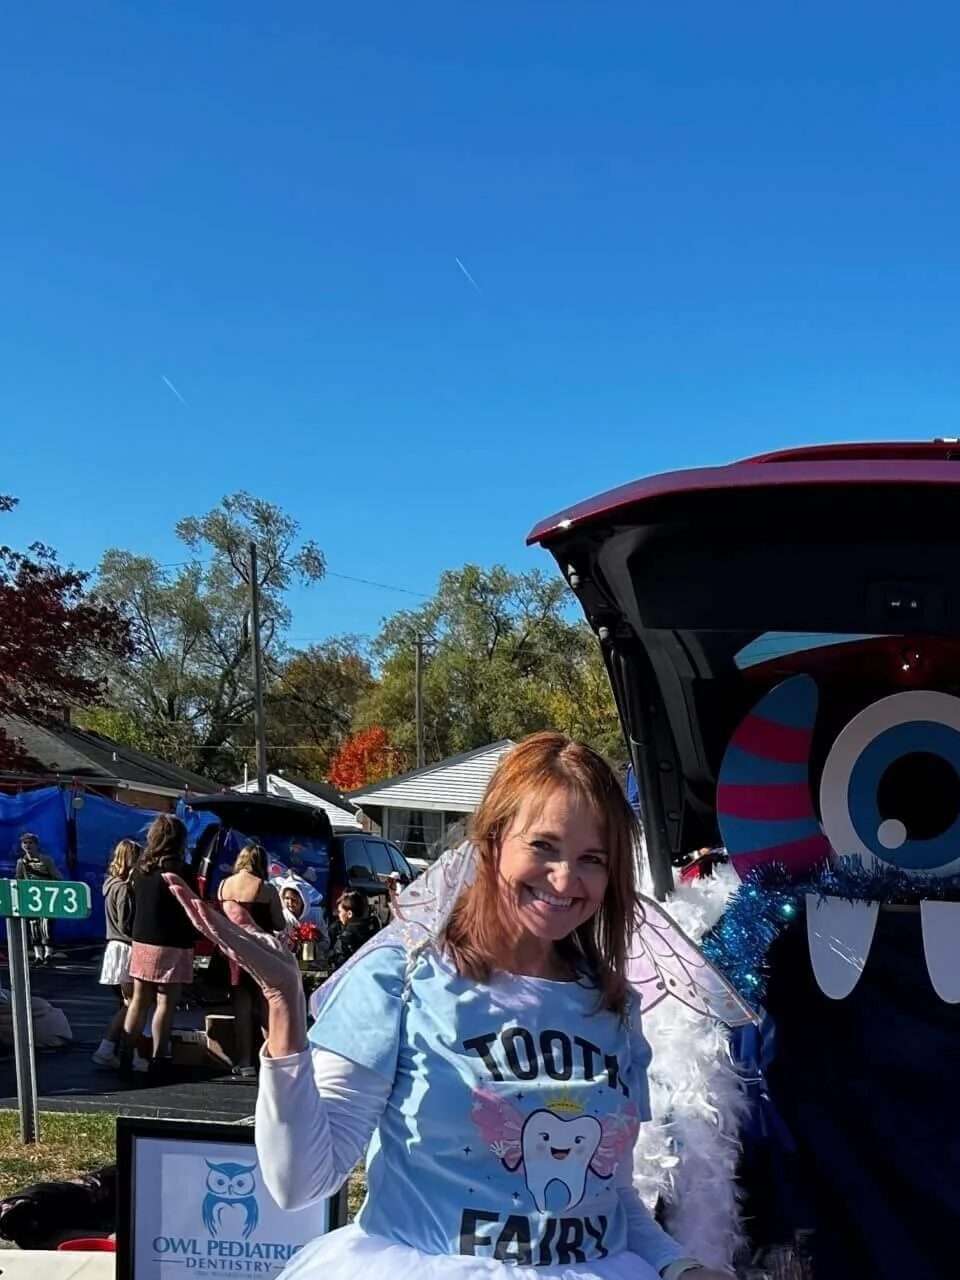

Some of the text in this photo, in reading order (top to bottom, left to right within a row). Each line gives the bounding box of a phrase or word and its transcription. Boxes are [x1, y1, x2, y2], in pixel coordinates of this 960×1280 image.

[28, 886, 78, 913] 373
[152, 1236, 201, 1255] OWL
[459, 1207, 608, 1267] FAIRY
[186, 1257, 272, 1273] DENTISTRY
